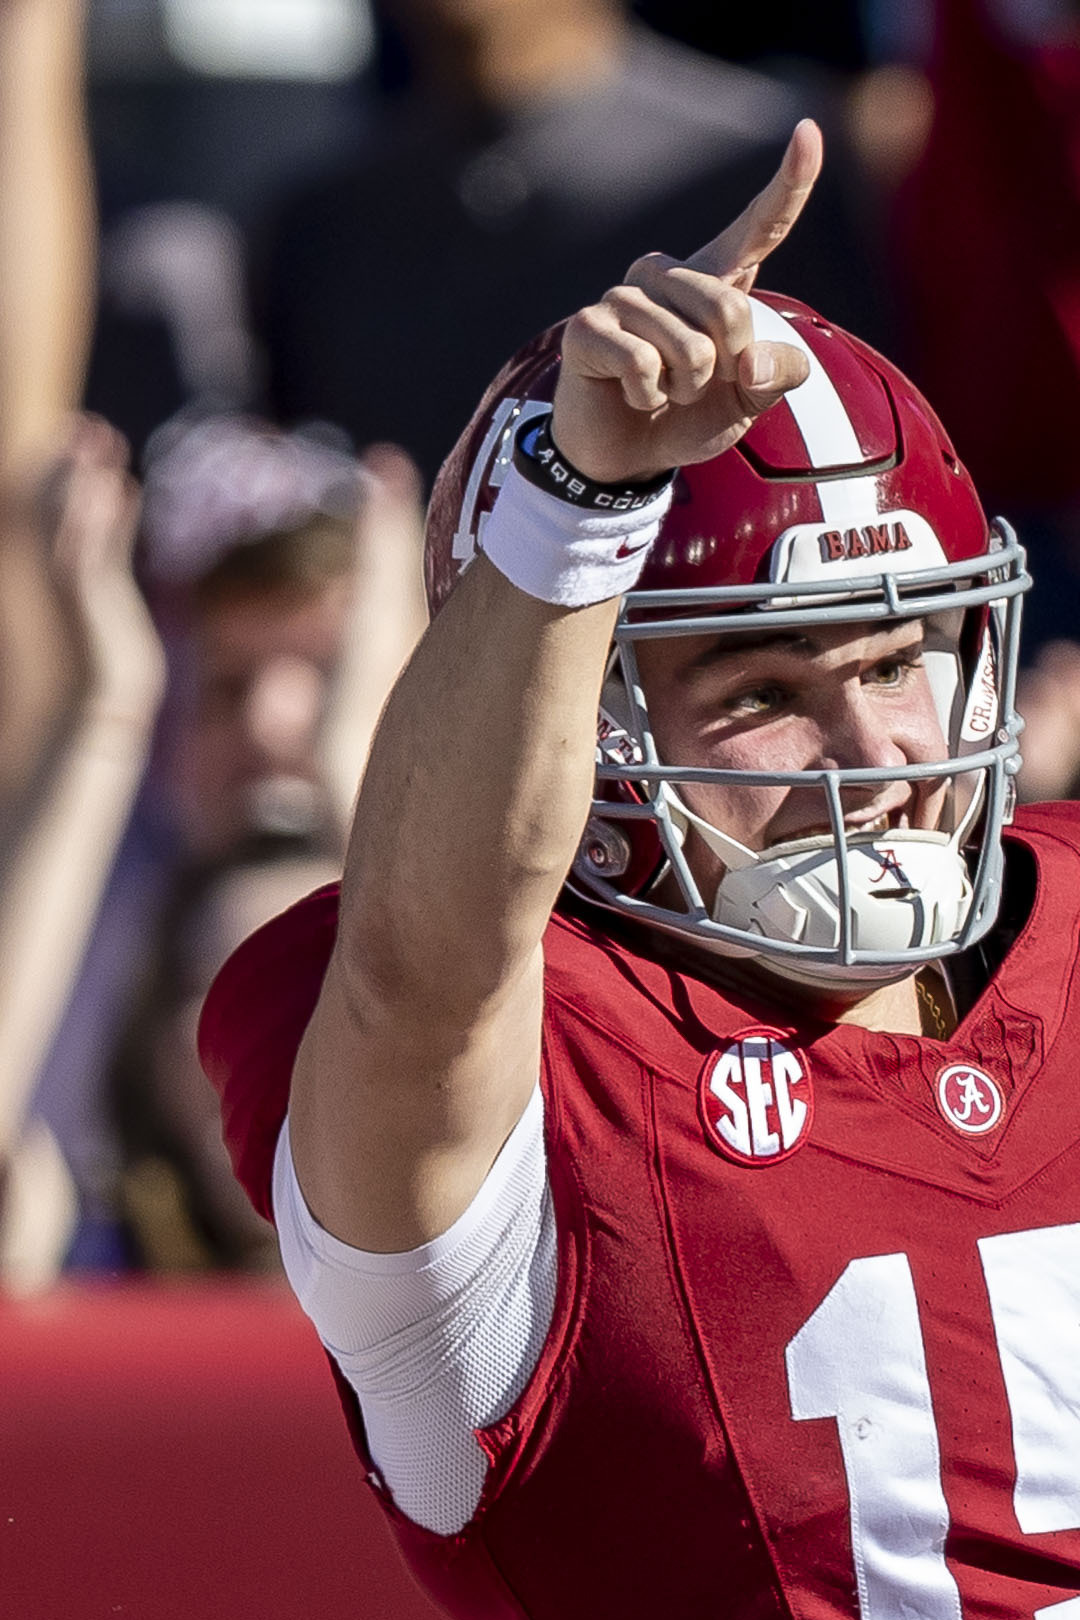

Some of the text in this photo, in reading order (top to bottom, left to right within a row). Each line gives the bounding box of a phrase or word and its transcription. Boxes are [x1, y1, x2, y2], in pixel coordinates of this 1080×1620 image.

[549, 460, 587, 496] QB
[817, 521, 913, 564] BAMA
[707, 1036, 808, 1158] SEC
[953, 1073, 990, 1120] A
